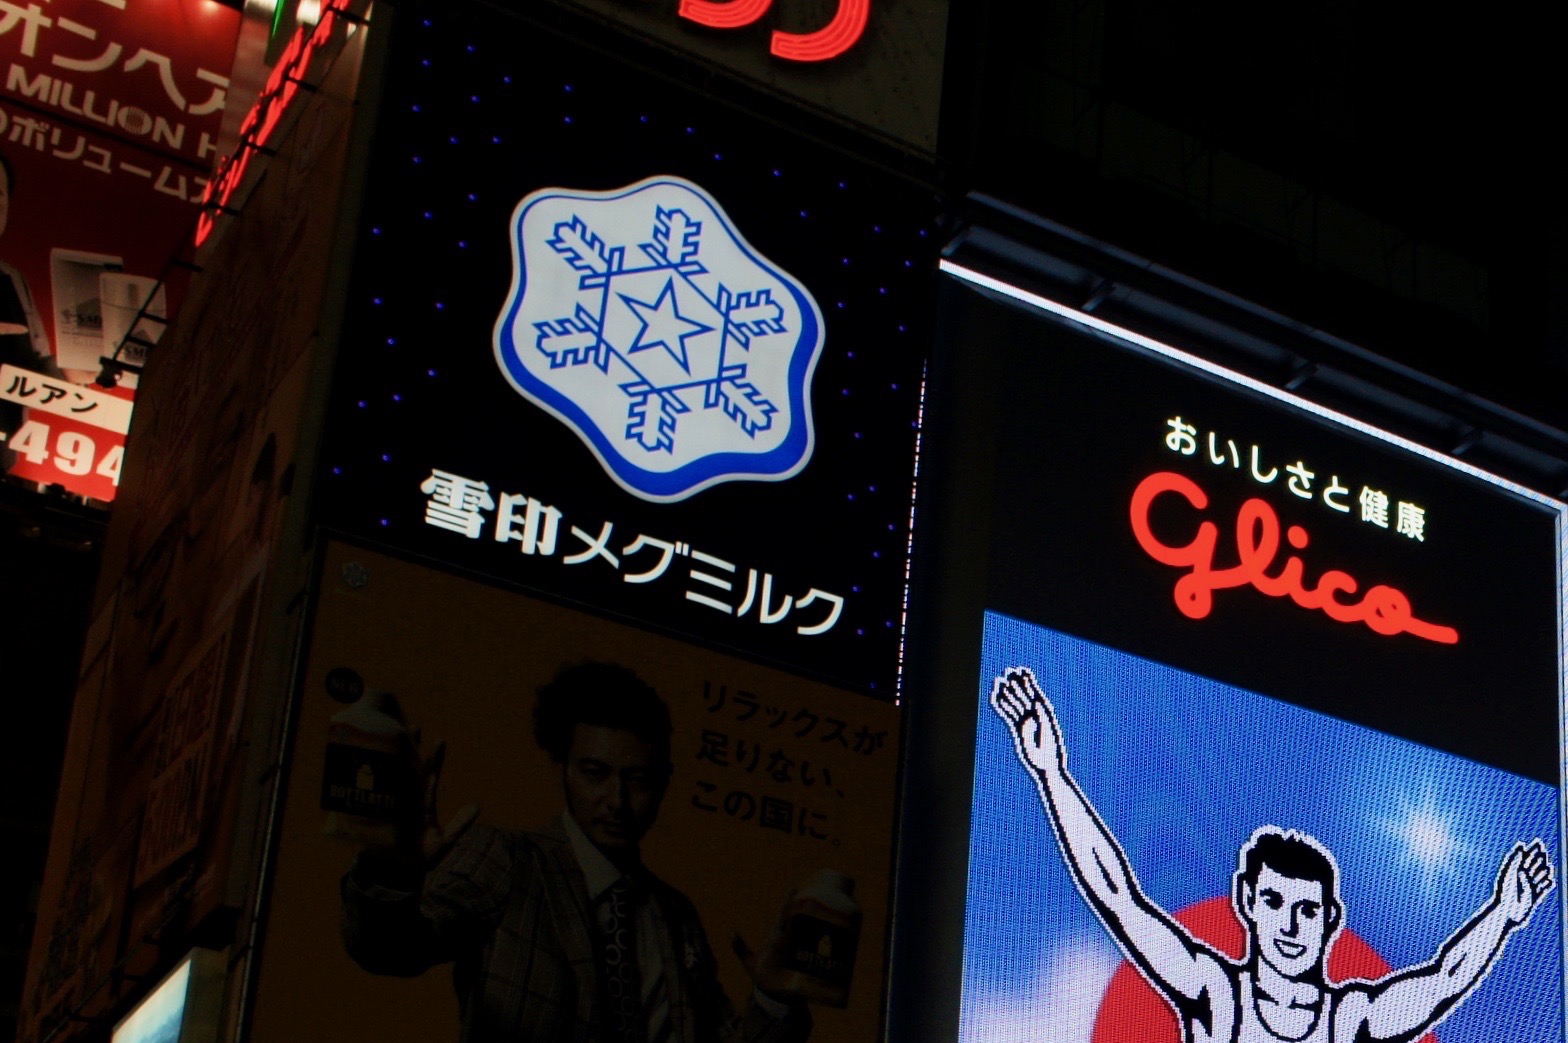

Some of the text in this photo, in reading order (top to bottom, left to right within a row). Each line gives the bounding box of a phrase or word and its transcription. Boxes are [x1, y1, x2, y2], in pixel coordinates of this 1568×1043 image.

[8, 63, 183, 150] MILLION
[1165, 415, 1426, 543] おいしさと健康
[420, 468, 845, 637] 雪印メグミルク
[1129, 471, 1459, 644] Glico
[702, 680, 887, 757] リラックスが
[697, 729, 846, 799] 足りない、
[691, 780, 841, 847] この国に。
